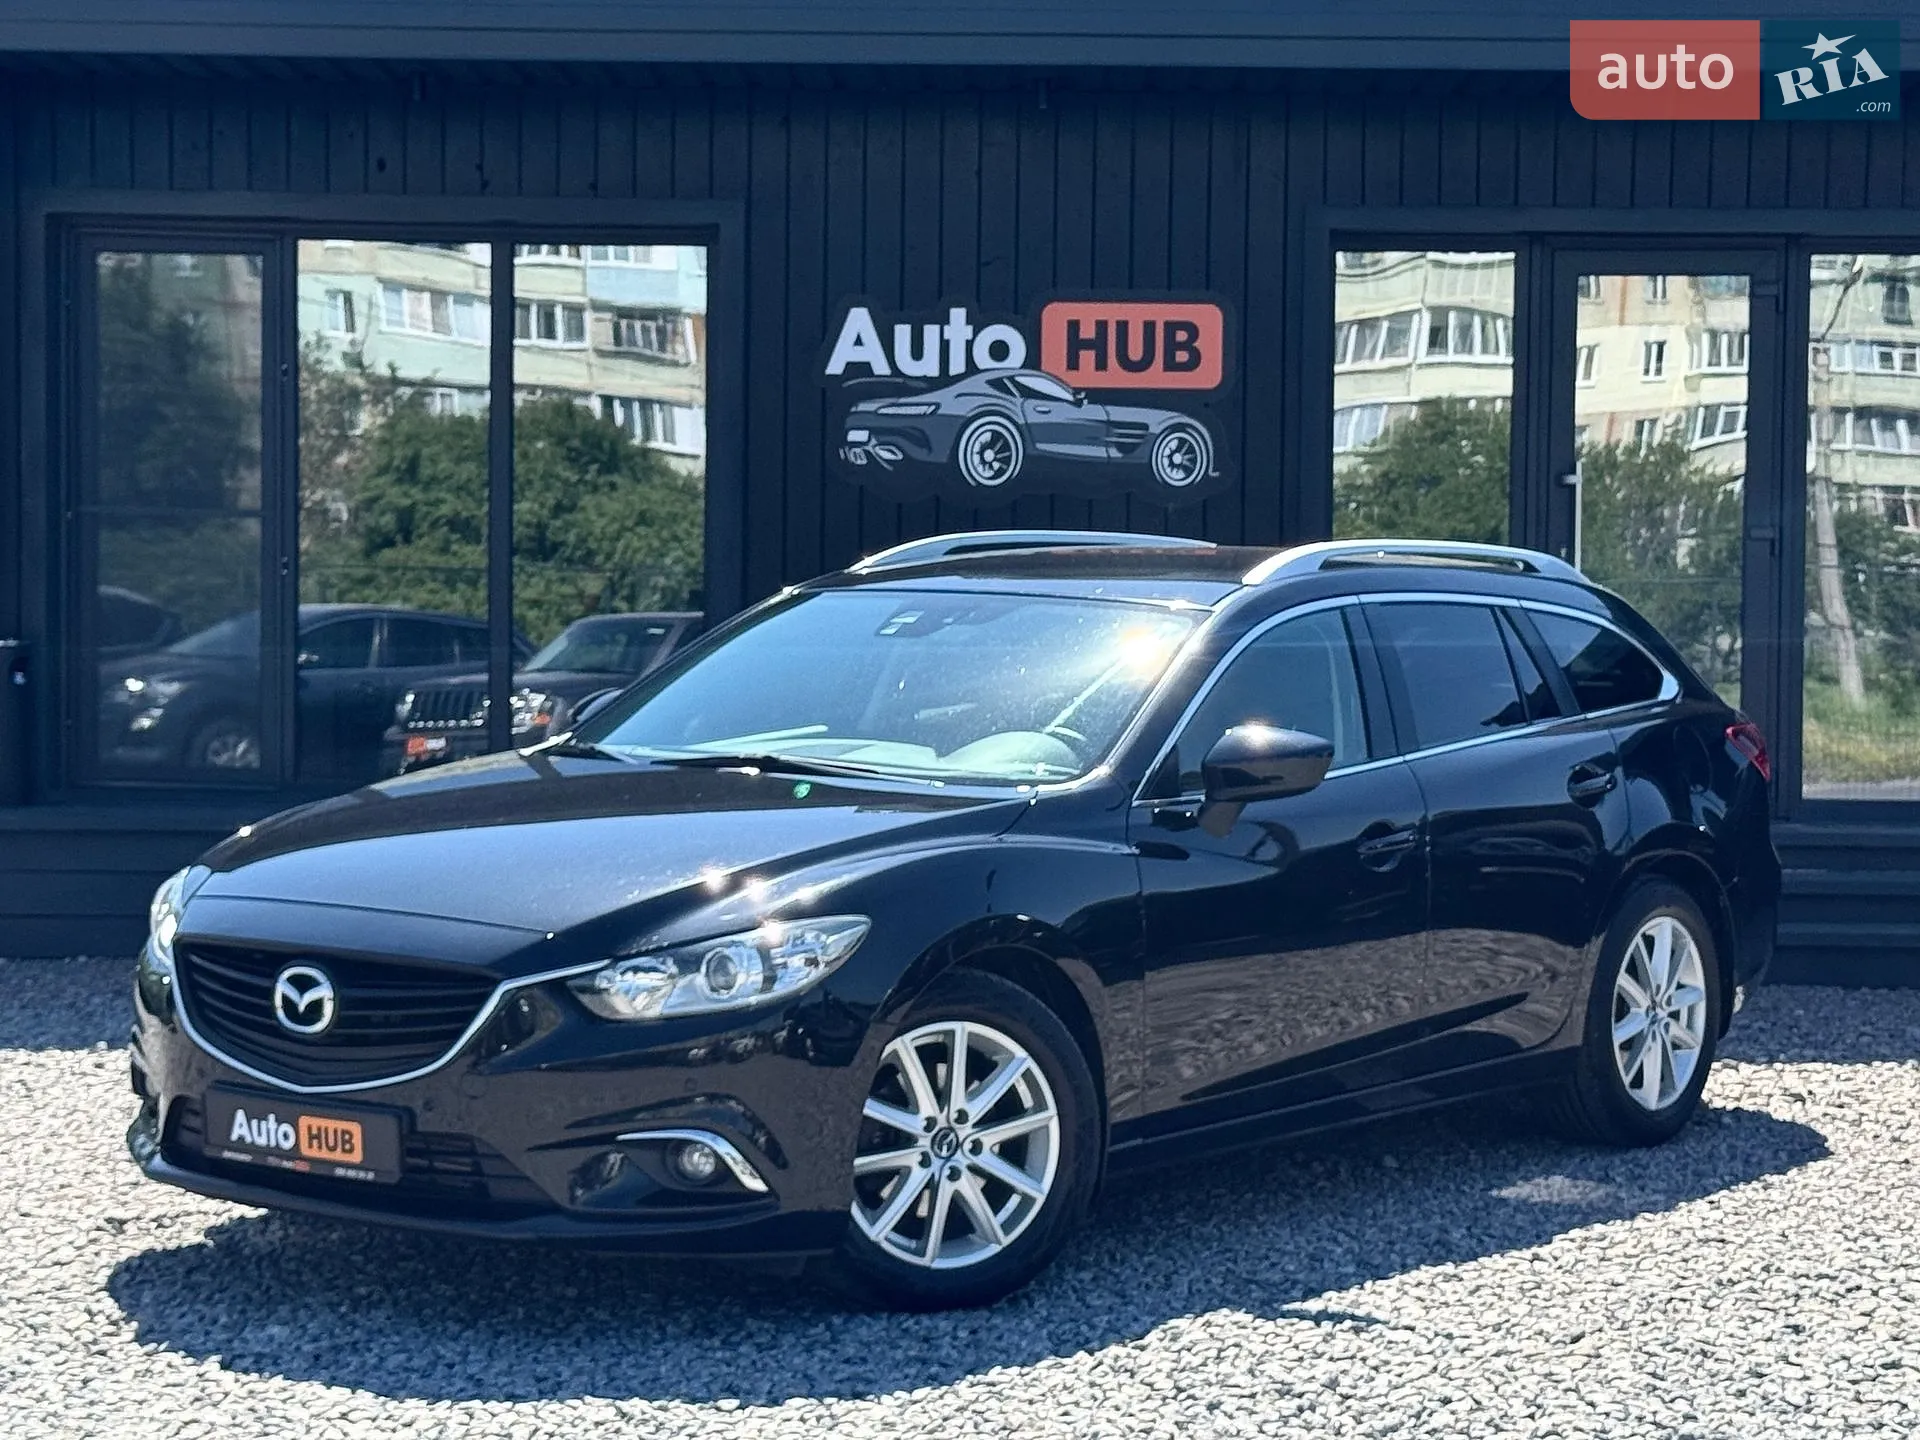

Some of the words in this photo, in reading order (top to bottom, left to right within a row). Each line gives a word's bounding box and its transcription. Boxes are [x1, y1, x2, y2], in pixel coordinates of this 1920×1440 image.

[825, 306, 1027, 377] Auto
[1066, 319, 1202, 373] HUB
[230, 1108, 297, 1150] Auto
[307, 1124, 355, 1153] HUB
